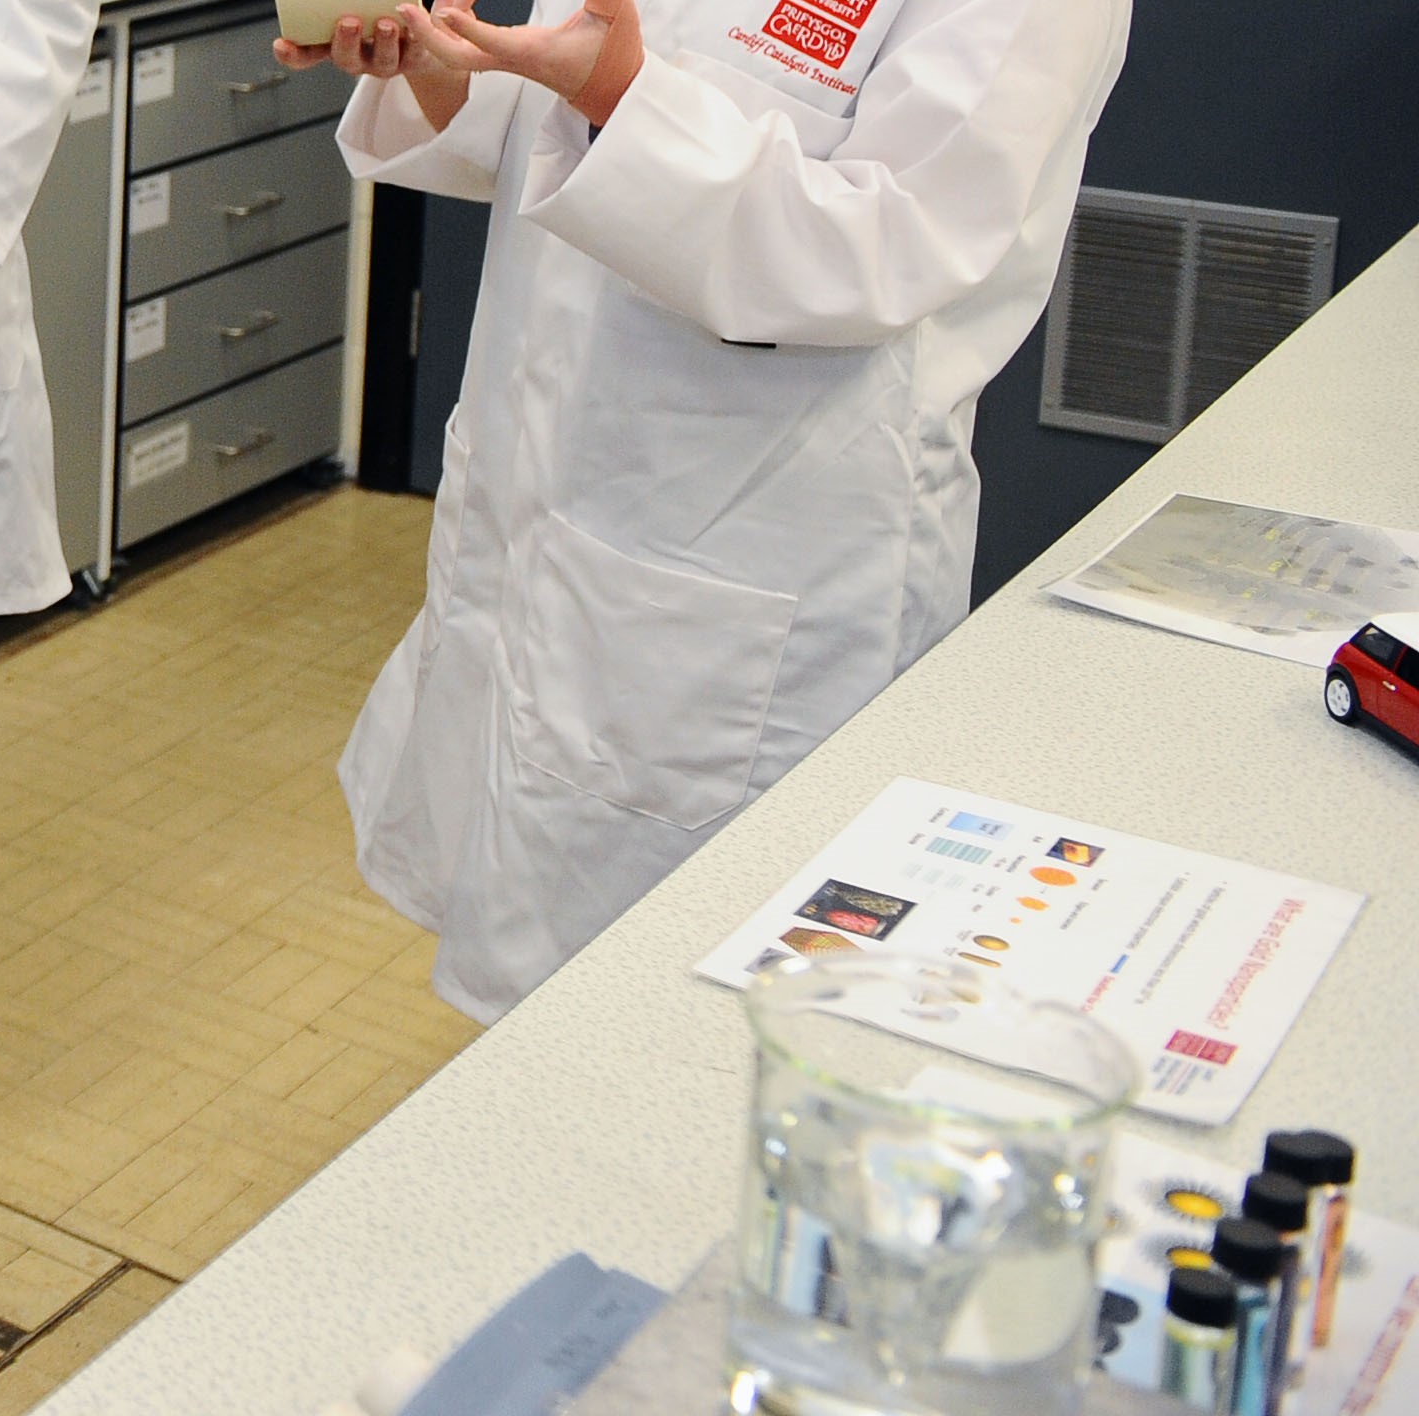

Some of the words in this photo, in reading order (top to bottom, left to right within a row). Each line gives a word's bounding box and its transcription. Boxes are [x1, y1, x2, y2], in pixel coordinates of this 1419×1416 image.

[780, 4, 847, 44] PRIFYSGOL
[727, 26, 768, 53] Cardiff
[763, 43, 811, 73] Catalysis
[811, 68, 857, 95] Institute
